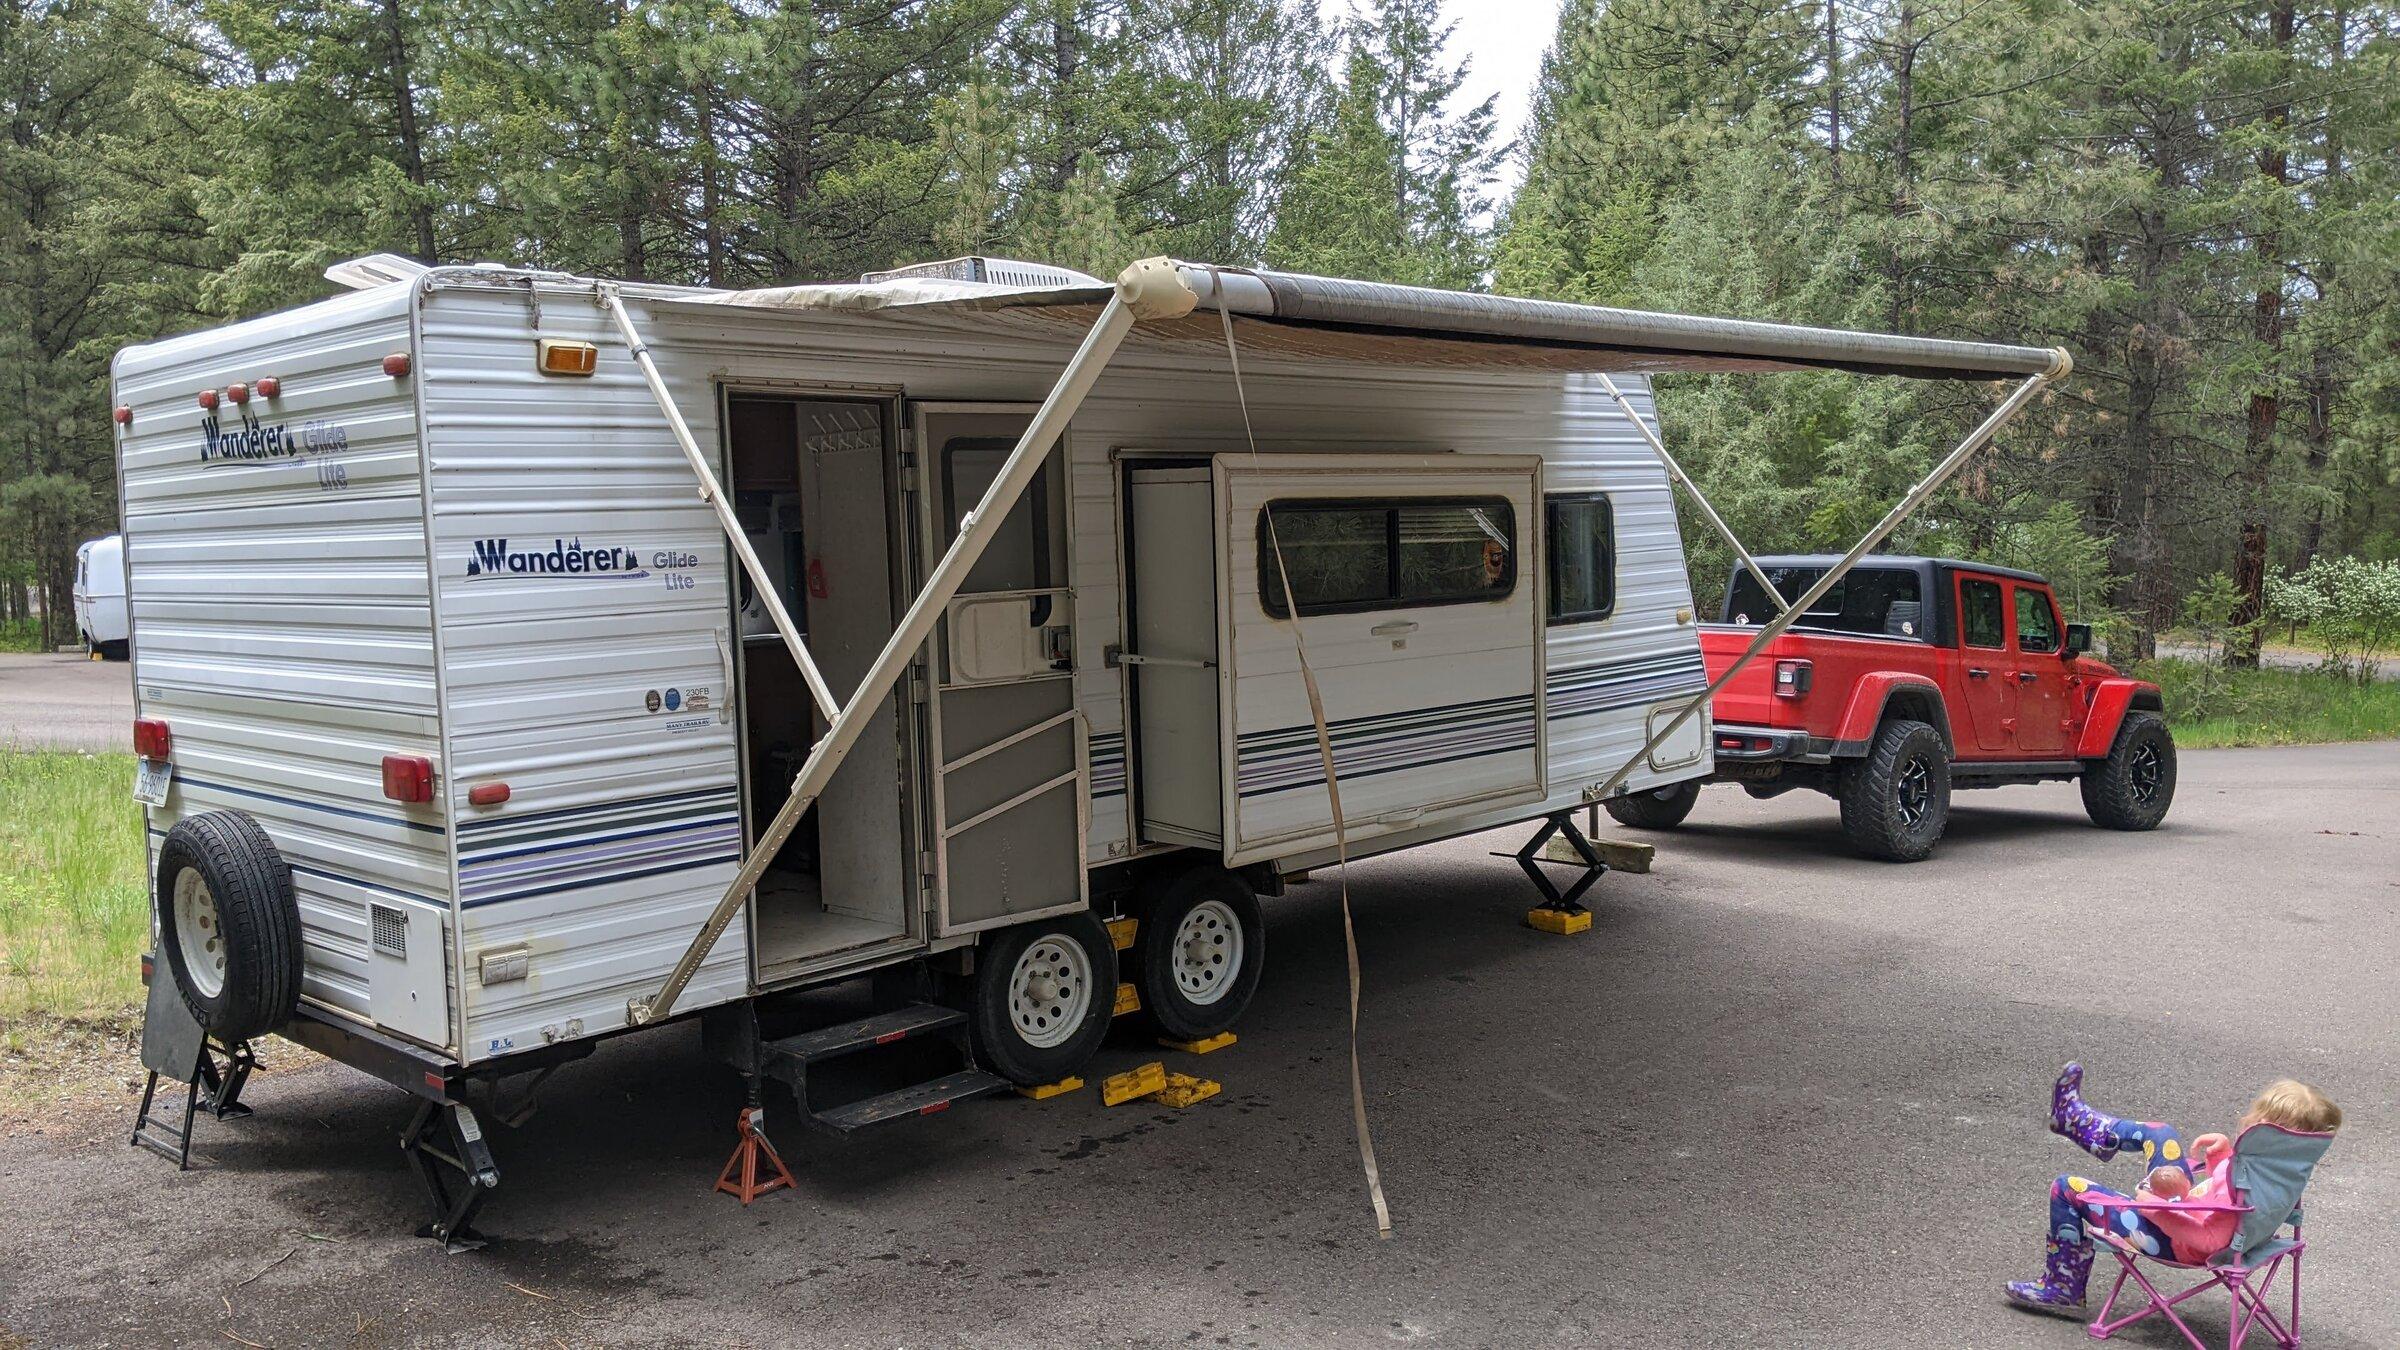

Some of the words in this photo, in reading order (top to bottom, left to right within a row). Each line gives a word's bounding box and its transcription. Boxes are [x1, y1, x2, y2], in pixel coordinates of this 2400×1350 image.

[202, 414, 285, 460] Wanderer
[302, 420, 348, 455] Glide
[317, 457, 348, 491] Lite
[474, 538, 621, 573] Wanderer
[652, 551, 698, 569] Glide
[664, 573, 694, 591] Lite
[685, 687, 709, 696] 230FB
